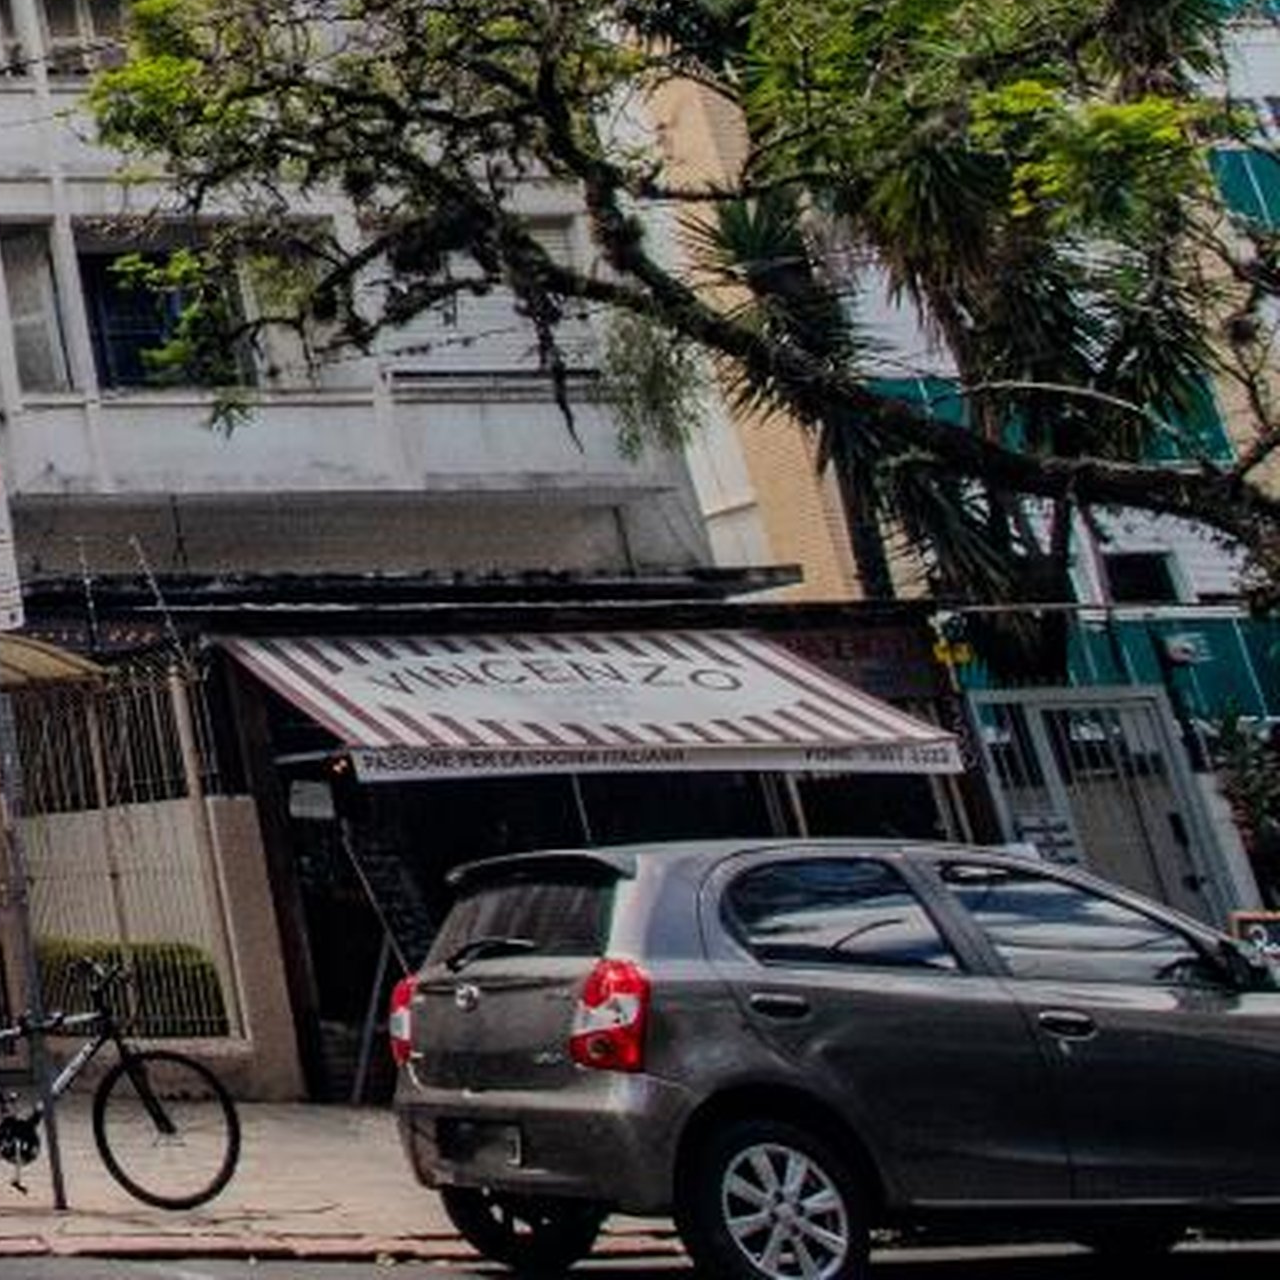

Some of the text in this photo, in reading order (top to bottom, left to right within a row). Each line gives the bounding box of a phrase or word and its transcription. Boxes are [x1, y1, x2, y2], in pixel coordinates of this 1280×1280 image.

[368, 660, 743, 695] VINCENZO
[363, 749, 456, 770] PASSIONE
[458, 749, 496, 768] PER
